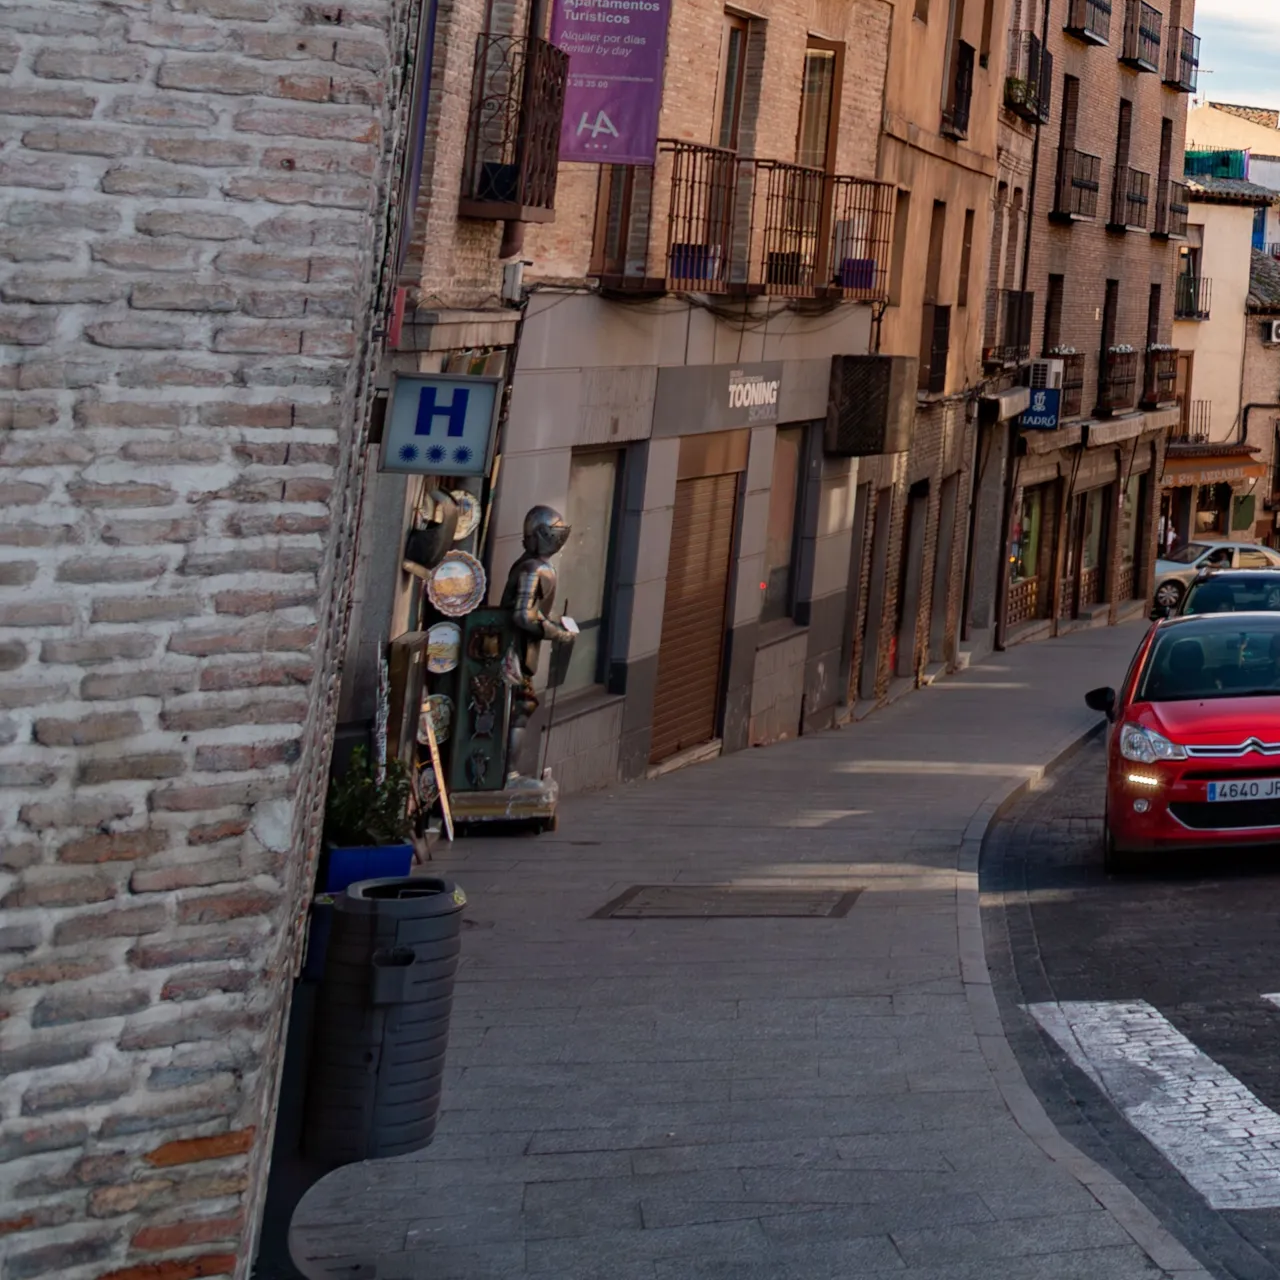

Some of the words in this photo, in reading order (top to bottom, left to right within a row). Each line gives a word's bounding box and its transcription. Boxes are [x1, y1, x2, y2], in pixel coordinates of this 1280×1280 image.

[563, 9, 630, 24] Turísticos
[561, 31, 601, 42] Alquiler
[603, 35, 620, 44] por
[559, 42, 593, 53] Rental
[596, 44, 609, 56] by
[611, 46, 632, 57] day
[729, 380, 778, 408] TOONING
[414, 386, 470, 437] H
[1219, 782, 1259, 798] 4640
